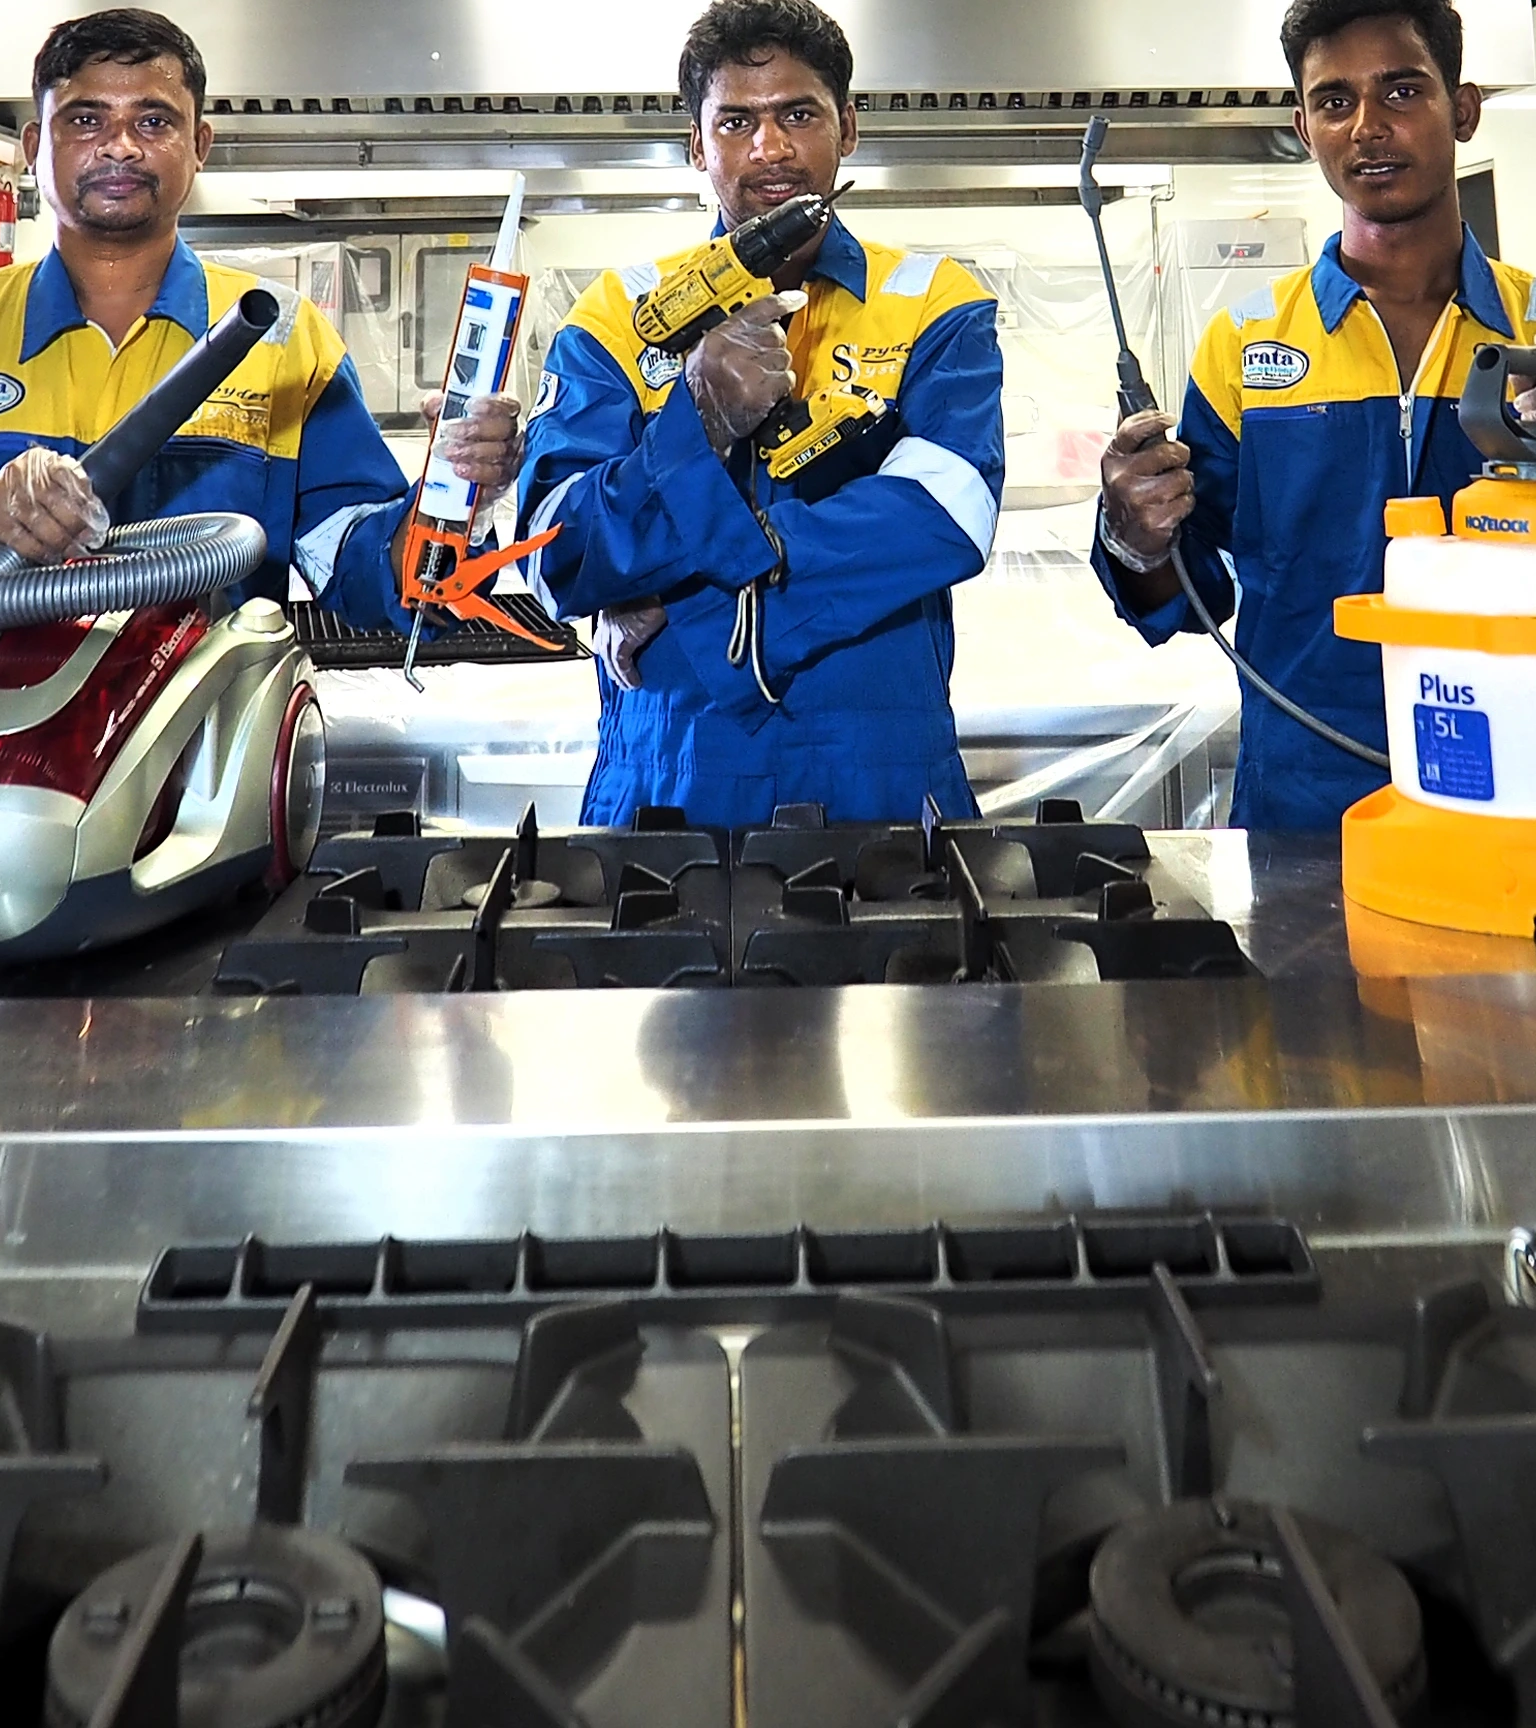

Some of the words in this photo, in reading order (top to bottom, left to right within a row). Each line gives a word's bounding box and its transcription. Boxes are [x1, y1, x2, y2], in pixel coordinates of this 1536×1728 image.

[1420, 673, 1475, 705] Plus
[1434, 711, 1464, 740] 5L
[345, 781, 408, 793] Electrolux
